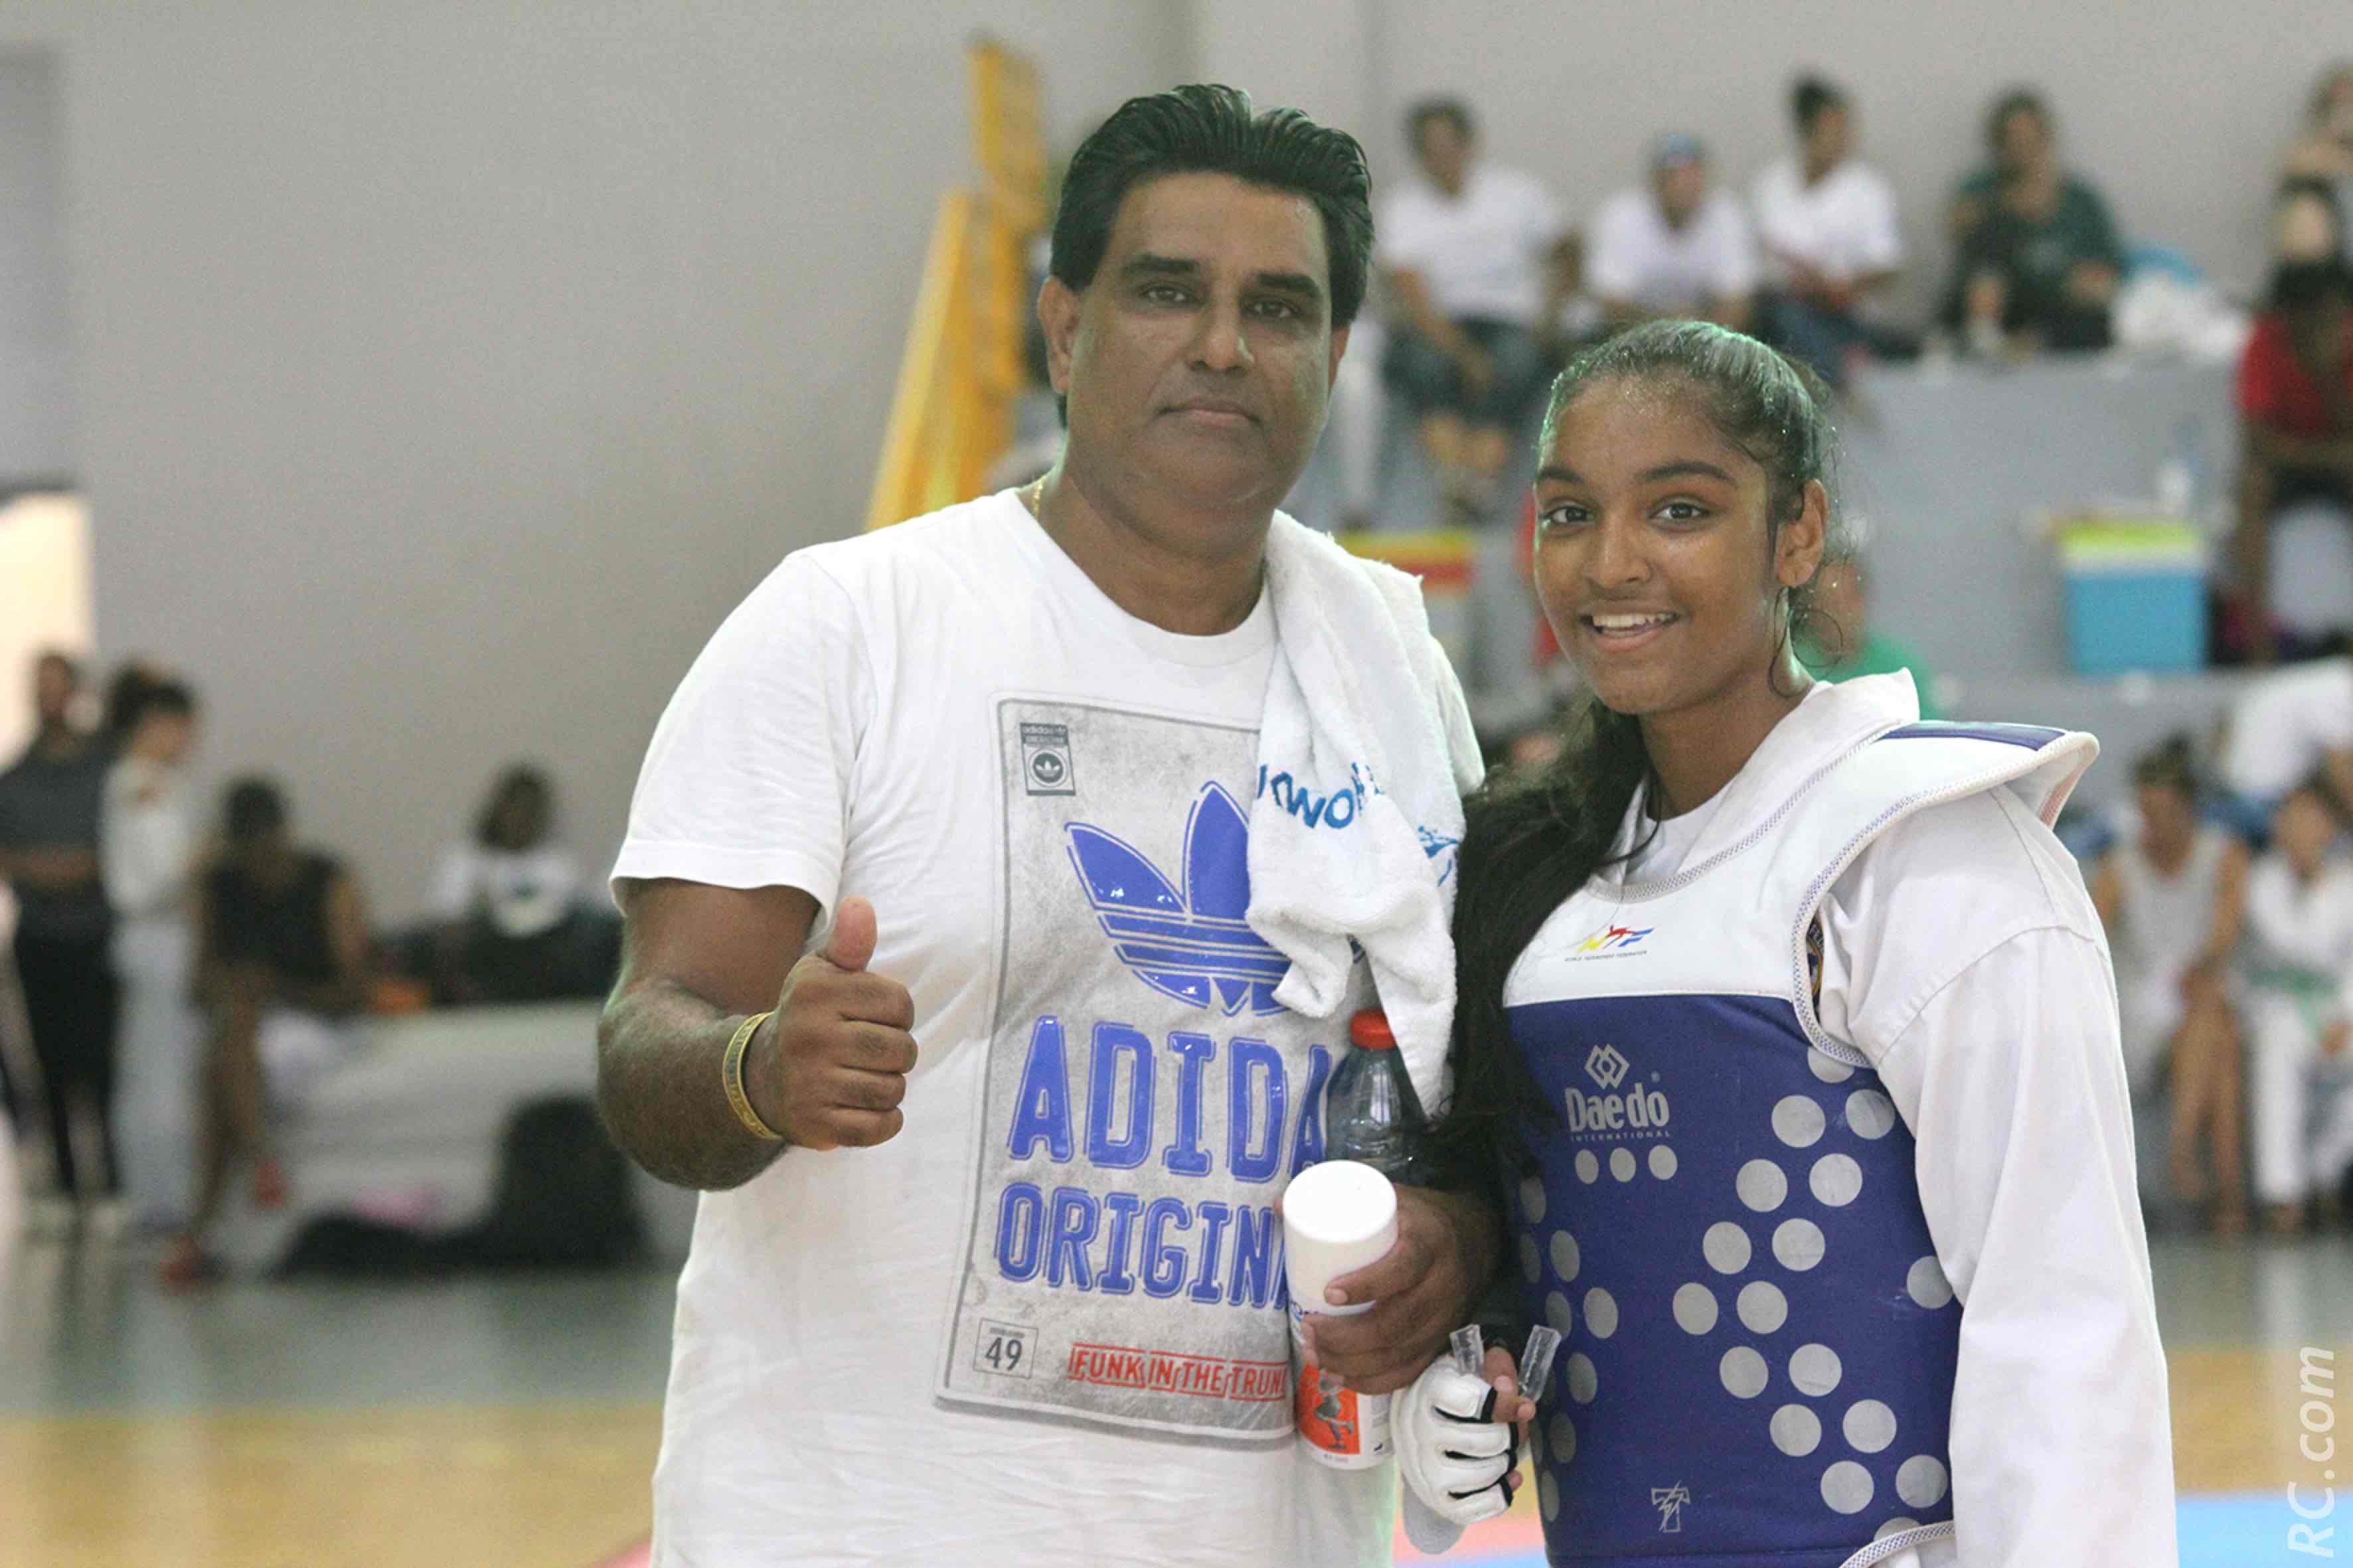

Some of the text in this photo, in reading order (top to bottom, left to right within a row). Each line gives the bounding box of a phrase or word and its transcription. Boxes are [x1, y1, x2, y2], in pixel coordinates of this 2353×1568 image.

[1564, 1083, 1670, 1131] Daedo
[995, 1183, 1290, 1310] ORIGIN
[984, 1337, 1022, 1371] 49
[1073, 1350, 1143, 1384] FUNK
[1147, 1358, 1175, 1388] IN
[1180, 1361, 1225, 1393] THE
